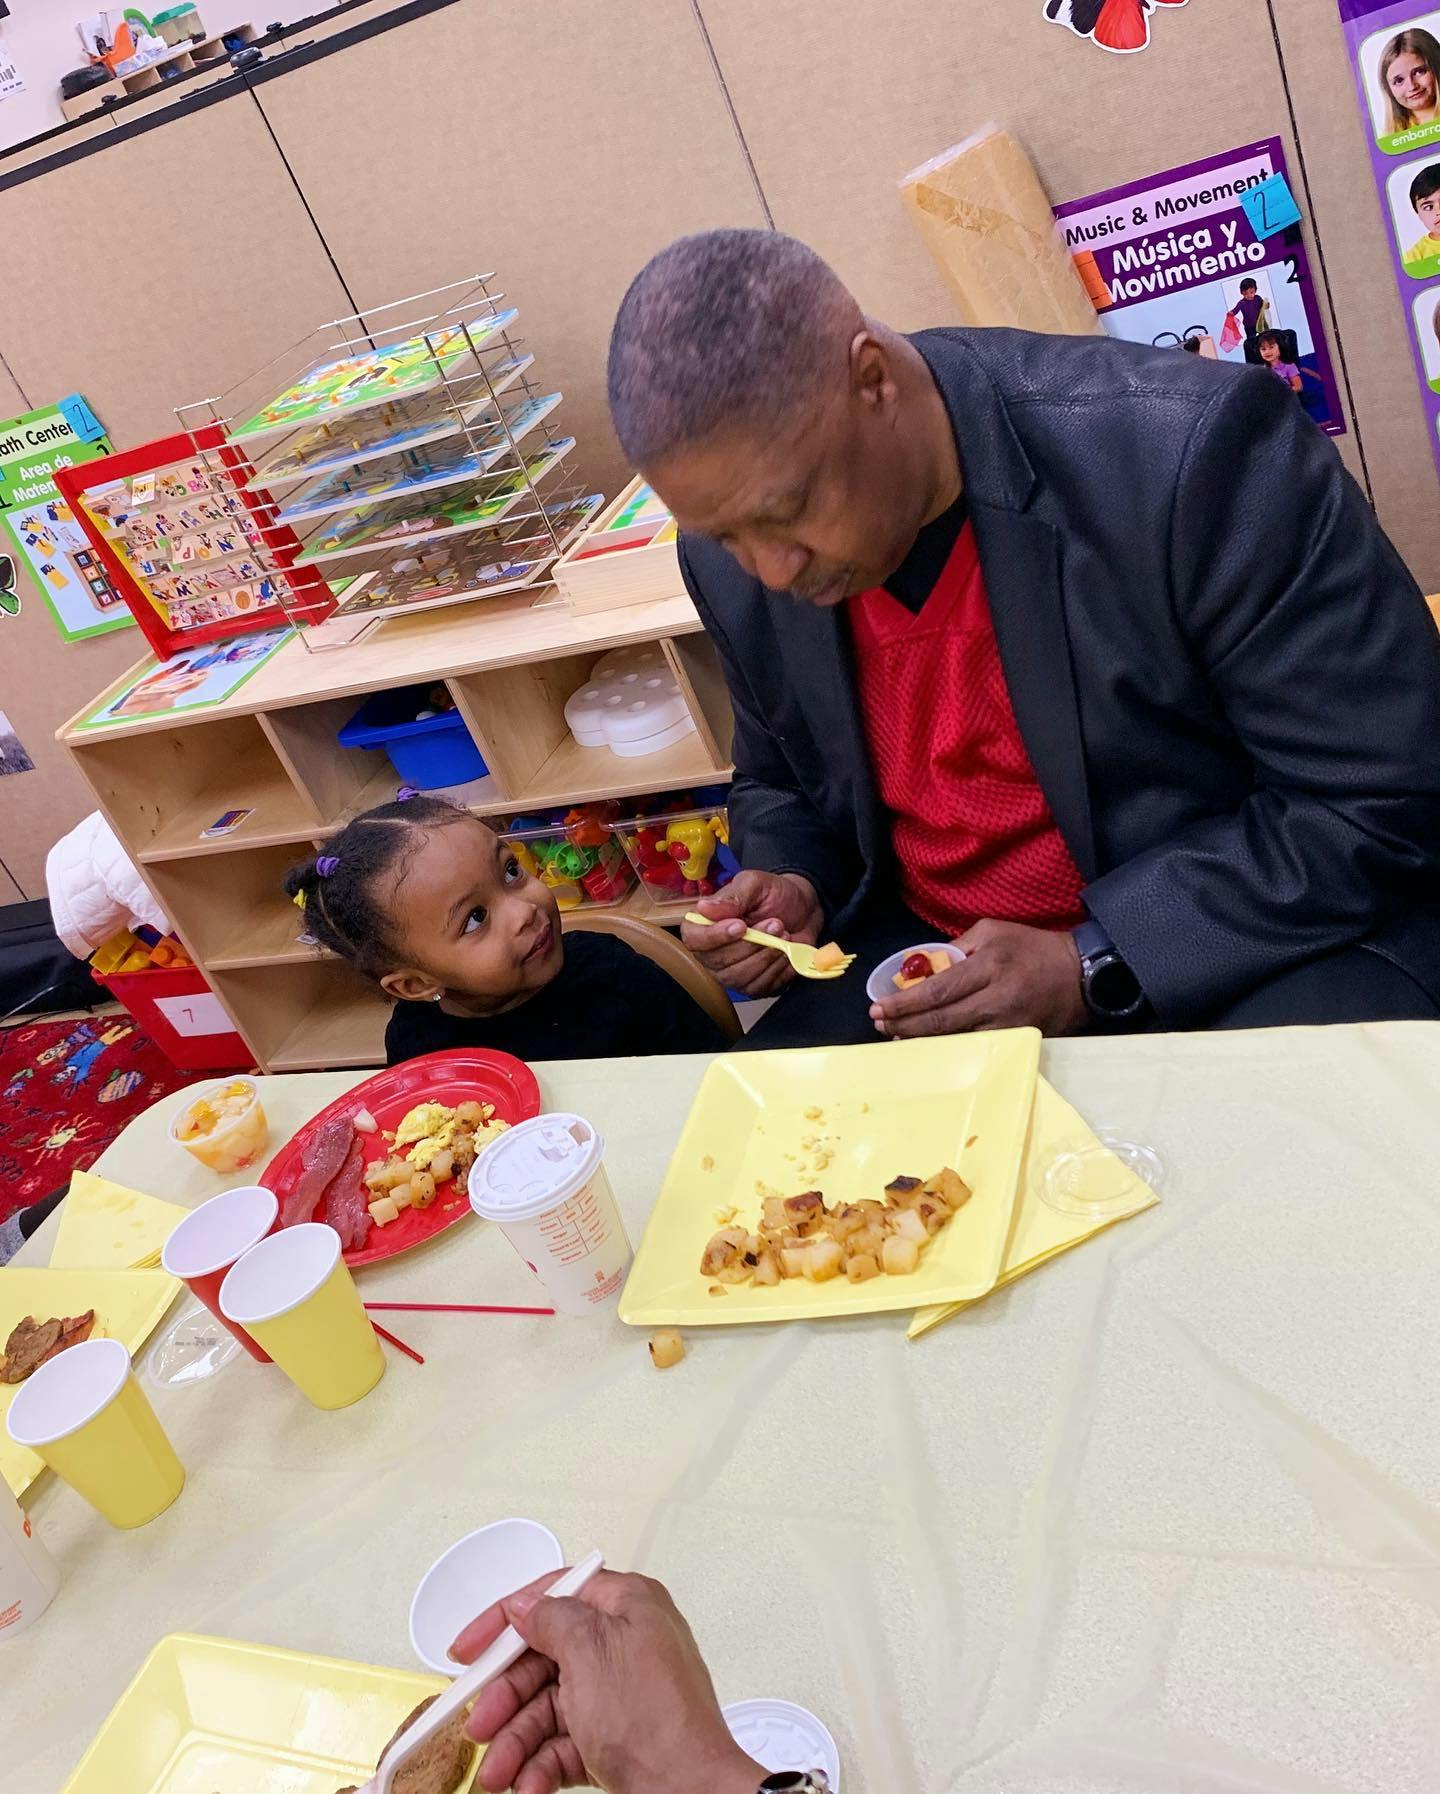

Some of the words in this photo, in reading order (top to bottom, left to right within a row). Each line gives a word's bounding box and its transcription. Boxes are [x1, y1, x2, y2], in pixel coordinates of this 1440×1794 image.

[1066, 215, 1126, 246] Music
[1132, 207, 1148, 225] &
[1155, 168, 1269, 219] Movement
[1253, 191, 1280, 231] 2
[1113, 228, 1212, 274] Música
[1220, 220, 1237, 247] y
[1104, 242, 1266, 303] Movimiento
[0, 436, 25, 457] ath
[19, 462, 53, 481] Area
[54, 454, 73, 469] de
[182, 1008, 194, 1024] 7
